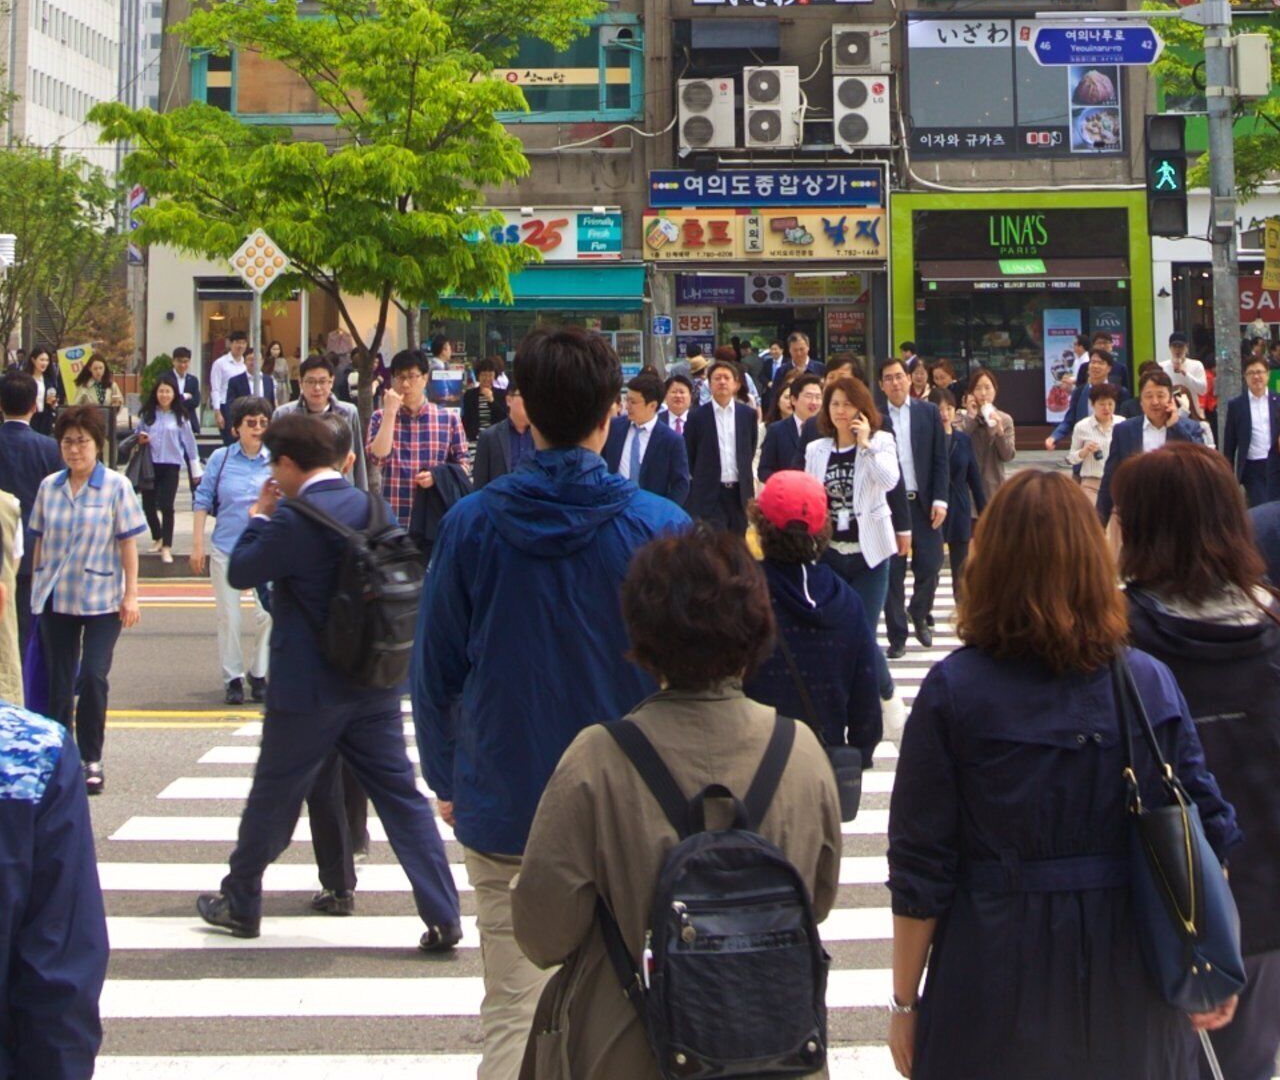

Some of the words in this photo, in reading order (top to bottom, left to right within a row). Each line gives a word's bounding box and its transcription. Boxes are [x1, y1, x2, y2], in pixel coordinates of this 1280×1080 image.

[937, 22, 1009, 44] いざわ
[1065, 29, 1126, 41] 여의나루로
[1039, 41, 1052, 51] 46
[1140, 40, 1153, 50] 42
[920, 132, 960, 147] 이자와
[683, 173, 848, 196] 여의도종합상가
[748, 217, 760, 250] 여의도
[989, 215, 1048, 247] LINA'S
[677, 314, 713, 331] 전당포
